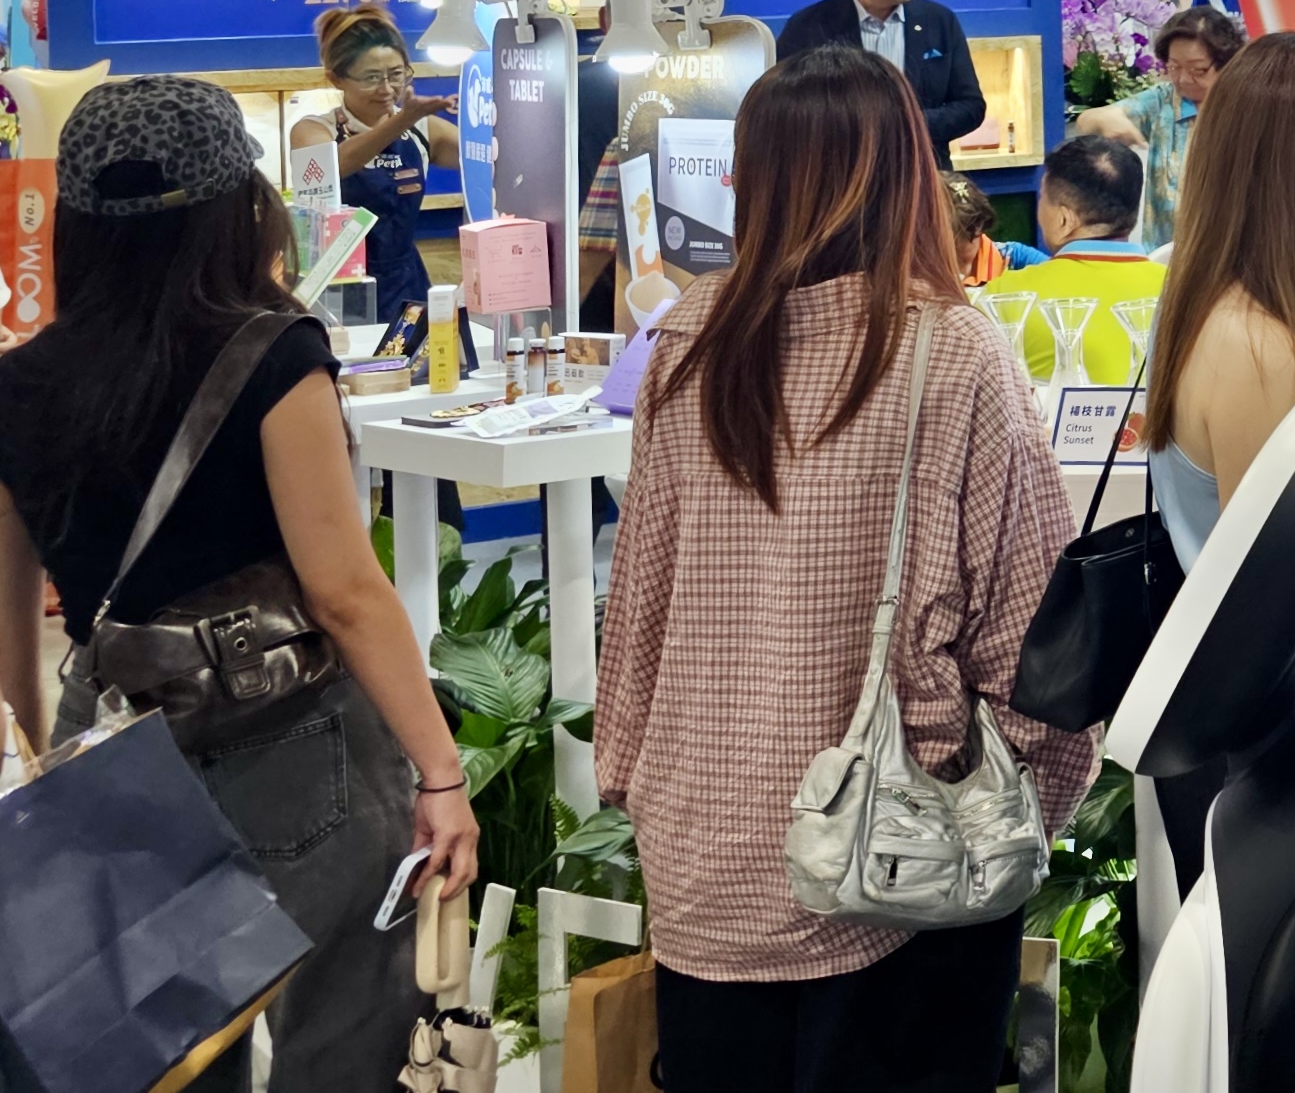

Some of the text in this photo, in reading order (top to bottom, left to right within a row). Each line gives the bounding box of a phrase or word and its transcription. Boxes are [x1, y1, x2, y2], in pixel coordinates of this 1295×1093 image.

[500, 48, 543, 70] CAPSULE
[644, 54, 726, 81] POWDER
[509, 79, 545, 103] TABLET
[620, 101, 638, 152] JUMBO
[638, 90, 660, 105] SIZE
[668, 156, 728, 178] PROTEIN
[1069, 405, 1117, 418] 楊枝甘露
[1065, 423, 1093, 433] Citrus
[1063, 435, 1094, 445] Sunset
